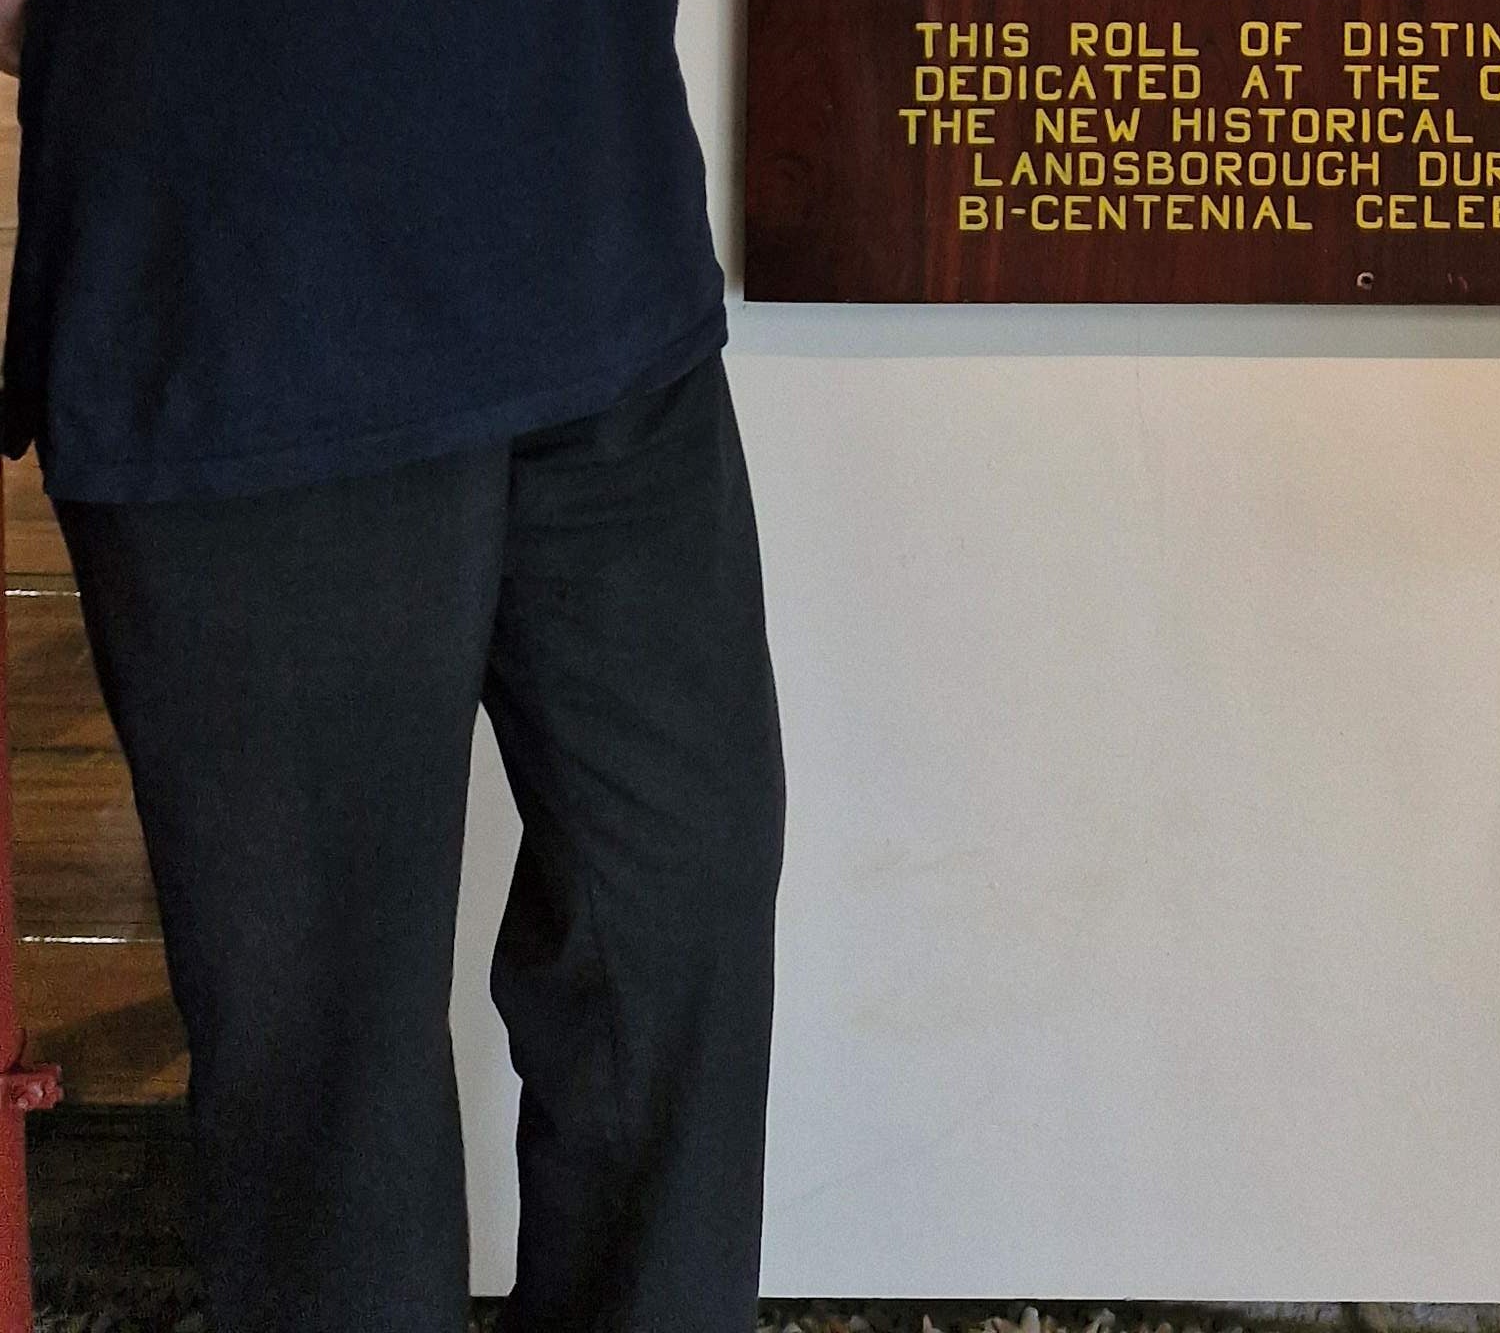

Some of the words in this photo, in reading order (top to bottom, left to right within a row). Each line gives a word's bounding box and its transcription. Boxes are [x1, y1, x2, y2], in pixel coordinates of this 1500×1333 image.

[915, 22, 1030, 59] THIS
[1070, 22, 1199, 59] ROLL
[1239, 22, 1302, 59] OF
[915, 64, 1201, 102] DEDICATED
[1242, 64, 1301, 102] AT
[1345, 64, 1440, 102] THE
[899, 108, 995, 146] THE
[1035, 108, 1141, 146] NEW
[1172, 108, 1473, 146] HISTORICAL
[973, 151, 1380, 189] LANDSBOROUGH
[958, 195, 1312, 232] BI-CENTENIAL
